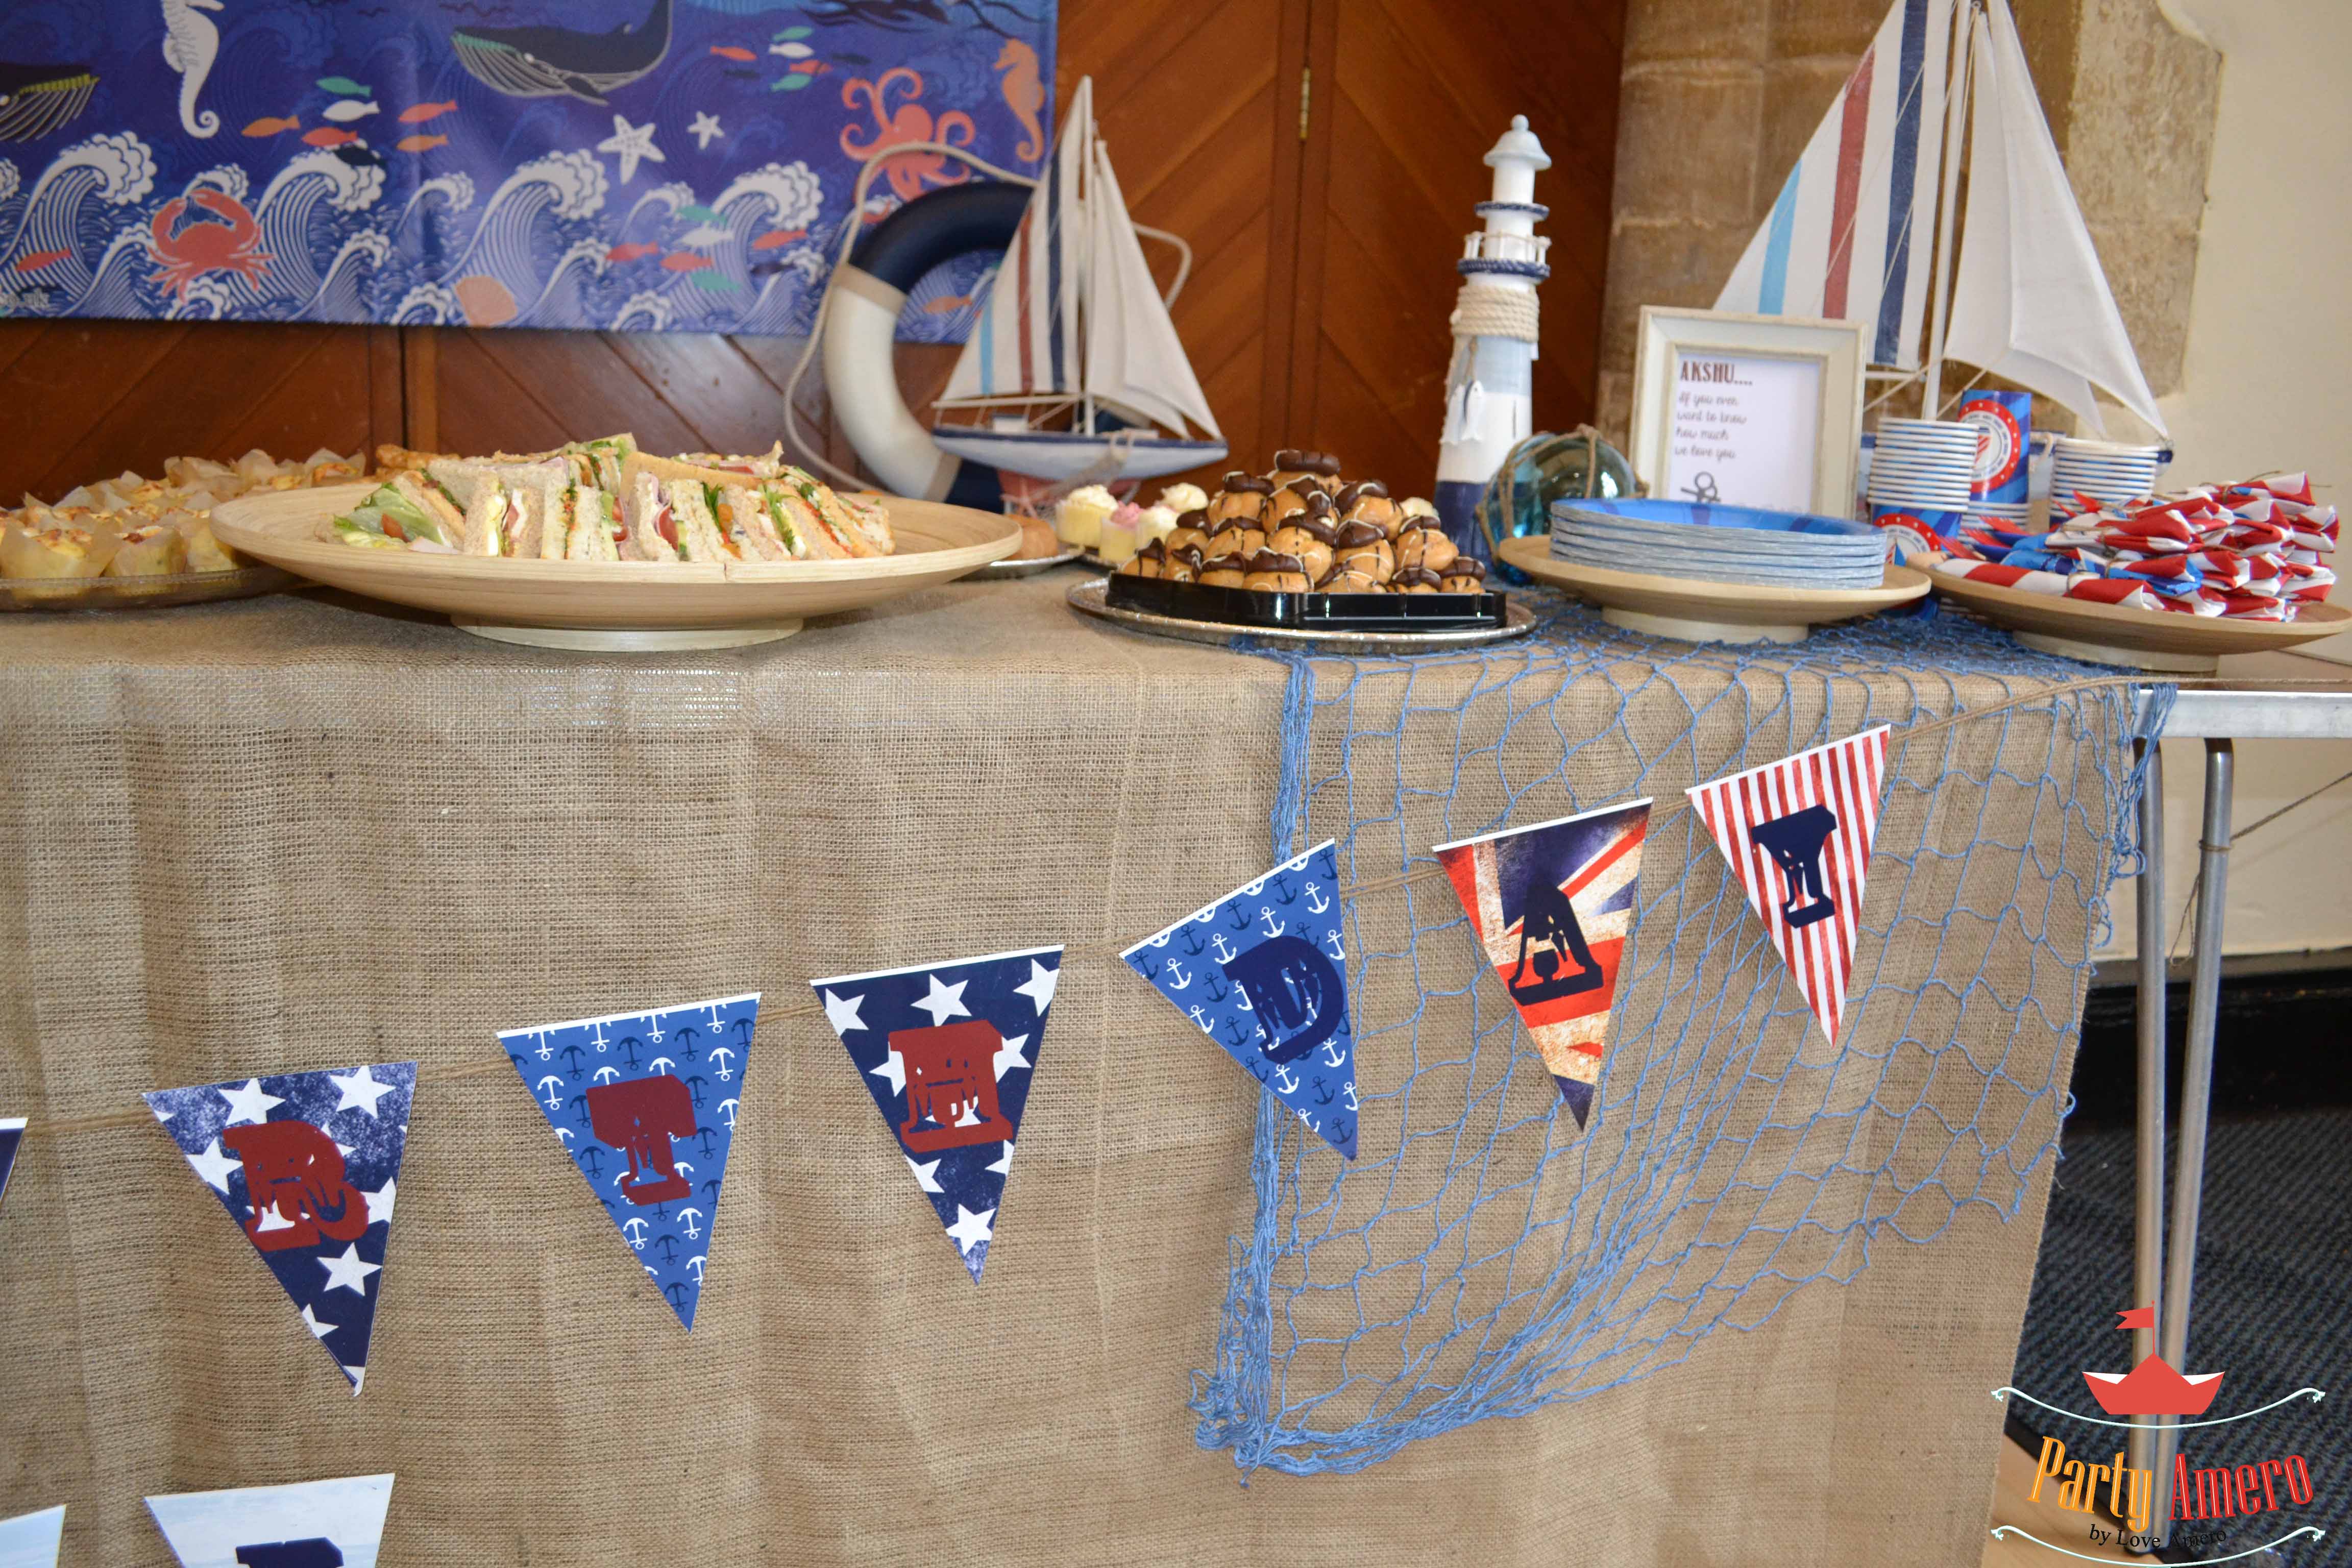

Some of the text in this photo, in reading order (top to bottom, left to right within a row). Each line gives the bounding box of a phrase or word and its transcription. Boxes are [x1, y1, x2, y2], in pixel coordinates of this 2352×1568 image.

[1694, 394, 1713, 407] you
[1706, 410, 1717, 422] to
[1674, 443, 1737, 463] we love you
